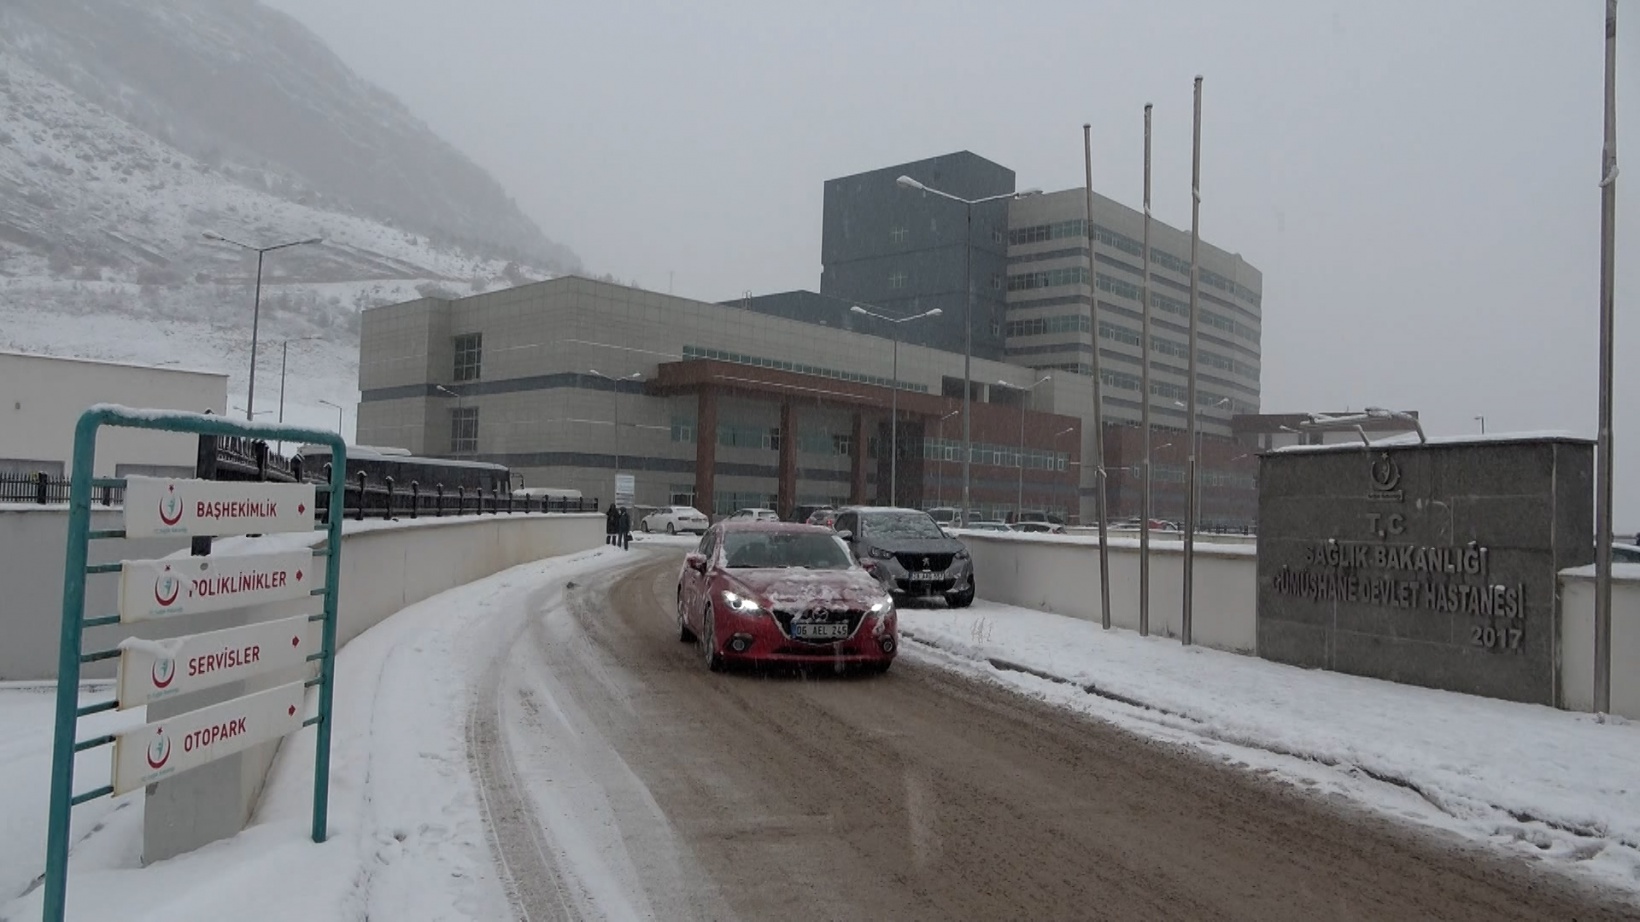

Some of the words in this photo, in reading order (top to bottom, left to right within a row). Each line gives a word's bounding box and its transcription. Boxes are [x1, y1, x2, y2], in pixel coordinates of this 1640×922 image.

[196, 498, 277, 519] BAŞHEKİMLİK
[1305, 539, 1370, 567] SAĞLIK
[1374, 541, 1487, 575] BAKANLIĞI
[189, 571, 287, 598] POLİKLİNİKLER
[1360, 576, 1420, 608] DEVLET
[1425, 582, 1524, 619] HASTANESİ
[797, 625, 807, 635] 06
[813, 625, 828, 635] AEL
[832, 625, 847, 635] 245
[1470, 626, 1523, 649] 2017
[188, 645, 260, 677] SERVİSLER
[183, 716, 247, 752] OTOPARK
